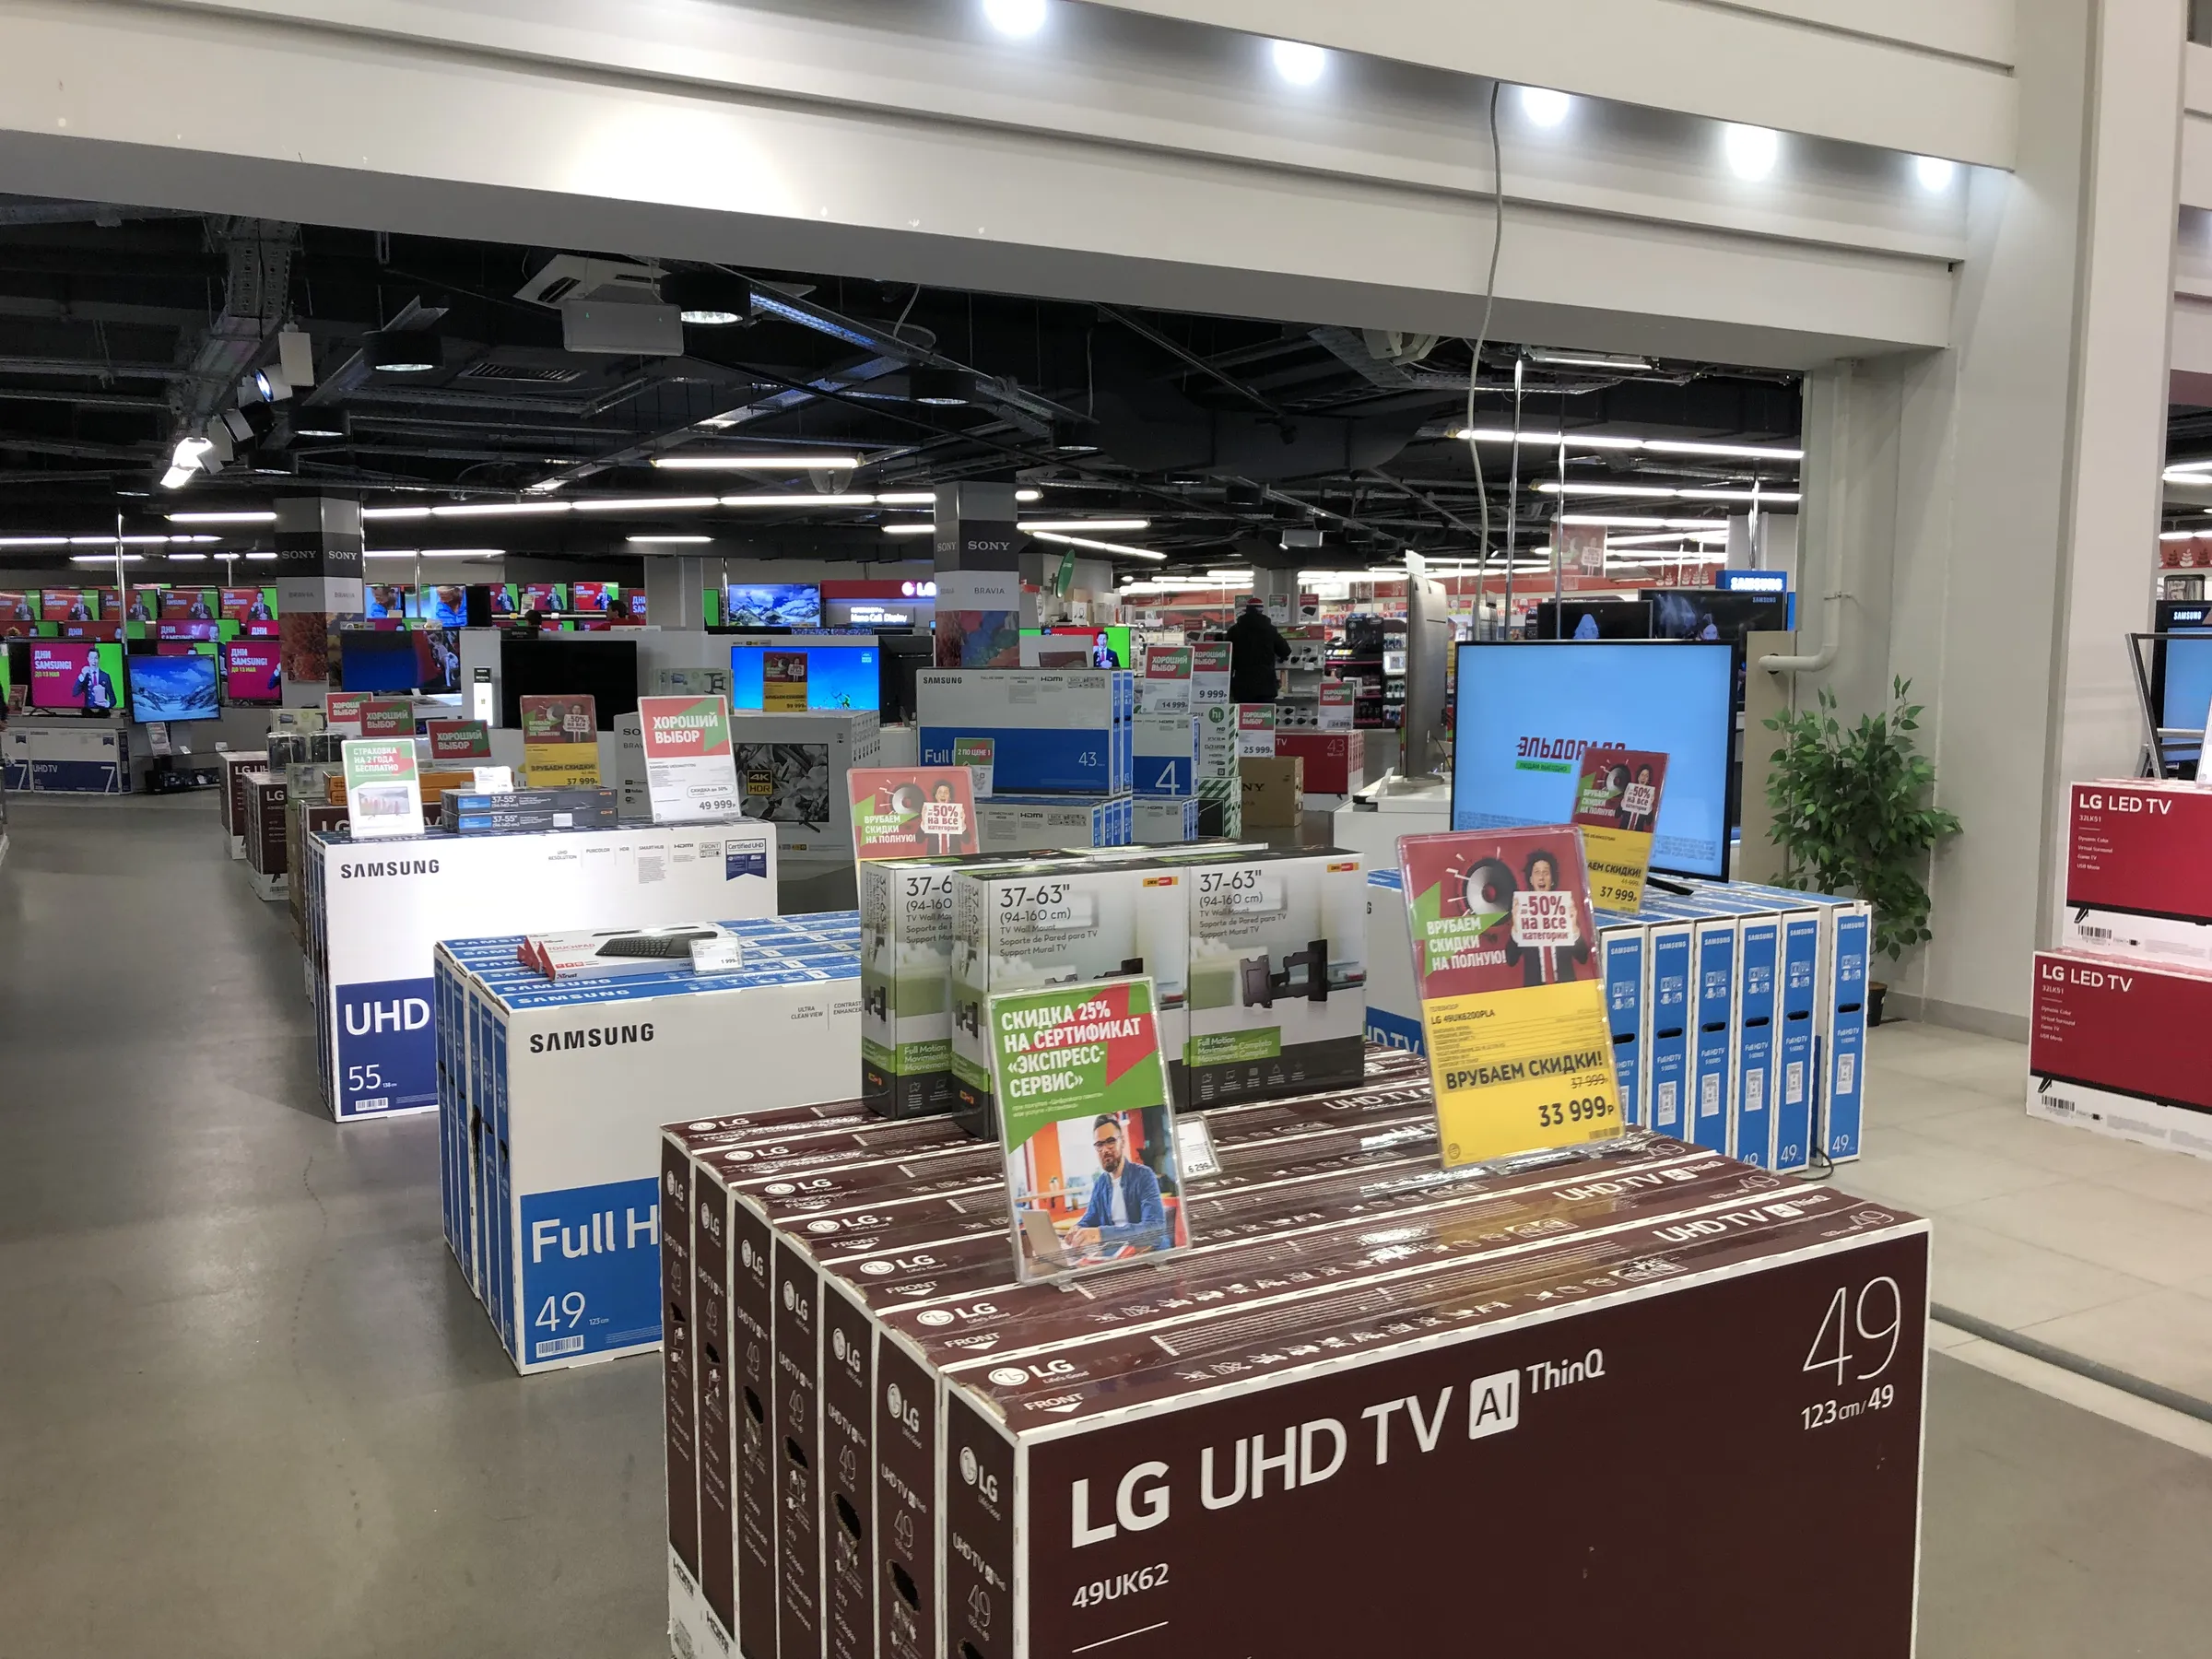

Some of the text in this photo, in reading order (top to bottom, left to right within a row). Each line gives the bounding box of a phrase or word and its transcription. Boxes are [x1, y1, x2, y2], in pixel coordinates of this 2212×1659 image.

[968, 540, 1010, 551] SONY
[328, 551, 357, 560] SONY
[1731, 577, 1783, 591] SAMSUNG
[2173, 611, 2201, 620] SAMSUNG
[252, 627, 267, 635] ДНИ
[34, 651, 51, 660] ДНИ
[1152, 653, 1188, 665] ХОРОШИЙ
[923, 676, 962, 685] SAMSUNG
[1199, 690, 1206, 699] 9
[367, 710, 409, 721] ХОРОШИЙ
[653, 712, 718, 729] ХОРОШИЙ
[367, 720, 396, 729] ВЫБОР
[437, 730, 482, 741] ХОРОШИЙ
[655, 730, 700, 744] ВЫБОР
[438, 741, 470, 749] ВЫБОР
[1327, 739, 1345, 753] 43
[1515, 736, 1626, 760] ЭЛЬДОР
[372, 756, 394, 764] ГОДА
[924, 748, 949, 764] Full
[1078, 751, 1098, 767] 43
[355, 764, 398, 772] БЕСПЛАТНО
[748, 773, 770, 782] 4K
[266, 791, 284, 801] LG
[749, 784, 771, 794] HDR
[1583, 789, 1610, 797] ВРУБАЕМ
[700, 801, 712, 809] 49
[2080, 794, 2171, 814] LG LED TV
[879, 834, 915, 842] ПОЛНУЮ!
[340, 859, 440, 879] SAMSUNG
[1605, 864, 1641, 877] СКИДКИ!
[1200, 870, 1262, 892] 37-63"
[1000, 883, 1070, 908] 37-63"
[1600, 887, 1613, 898] 37
[1200, 892, 1263, 909] (94-160 cm)
[1000, 908, 1071, 925] (94-160 cm)
[1522, 916, 1567, 930] на все
[1427, 917, 1482, 935] ВРУБАЕМ
[1790, 928, 1814, 936] SAMSUNG
[1000, 936, 1030, 947] Soporte
[1032, 935, 1041, 943] de
[1044, 933, 1065, 942] Pared
[1068, 933, 1085, 941] para
[1522, 930, 1569, 942] категории
[547, 943, 595, 952] TOUCHPAD
[1430, 935, 1479, 953] СКИДКИ
[1000, 947, 1031, 958] Support
[1033, 946, 1054, 955] Mural
[1432, 950, 1507, 970] НА ПОЛНУЮ!
[2042, 964, 2133, 992] LG LED TV
[517, 989, 630, 1004] SAMSUNG
[833, 1006, 862, 1015] ENHANCER
[834, 1001, 862, 1009] CONTRAST
[345, 998, 430, 1035] UHD
[807, 1010, 824, 1018] VIEW
[1001, 999, 1111, 1030] СКИДКА 25%
[1431, 1016, 1441, 1024] LG
[529, 1023, 654, 1053] SAMSUNG
[1004, 1018, 1142, 1053] НА СЕРТИФИКАТ
[1006, 1045, 1105, 1074] «ЭКСПРЕСС-
[1446, 1051, 1603, 1089] ВРУБАЕМ СКИДКИ!
[348, 1065, 382, 1091] 55
[1009, 1070, 1084, 1098] СЕРВИС»
[1538, 1102, 1563, 1127] 33
[1832, 1135, 1850, 1151] 49
[1781, 1145, 1797, 1161] 49
[841, 1215, 877, 1227] LG
[1653, 1220, 1727, 1241] UHD
[1724, 1209, 1768, 1226] TV
[1790, 1194, 1832, 1207] ThinQ
[532, 1204, 659, 1264] Full H
[535, 1291, 586, 1332] 49
[955, 1302, 999, 1319] LG
[1803, 1277, 1901, 1387] 49
[944, 1333, 999, 1348] FRONT
[1027, 1359, 1076, 1379] LG
[1065, 1371, 1089, 1381] Good
[1024, 1393, 1084, 1411] FRONT
[1071, 1461, 1171, 1548] LG
[1200, 1418, 1347, 1511] UHD
[1360, 1386, 1453, 1465] TV
[1526, 1348, 1606, 1394] ThinQ
[1072, 1563, 1170, 1609] 49UK62
